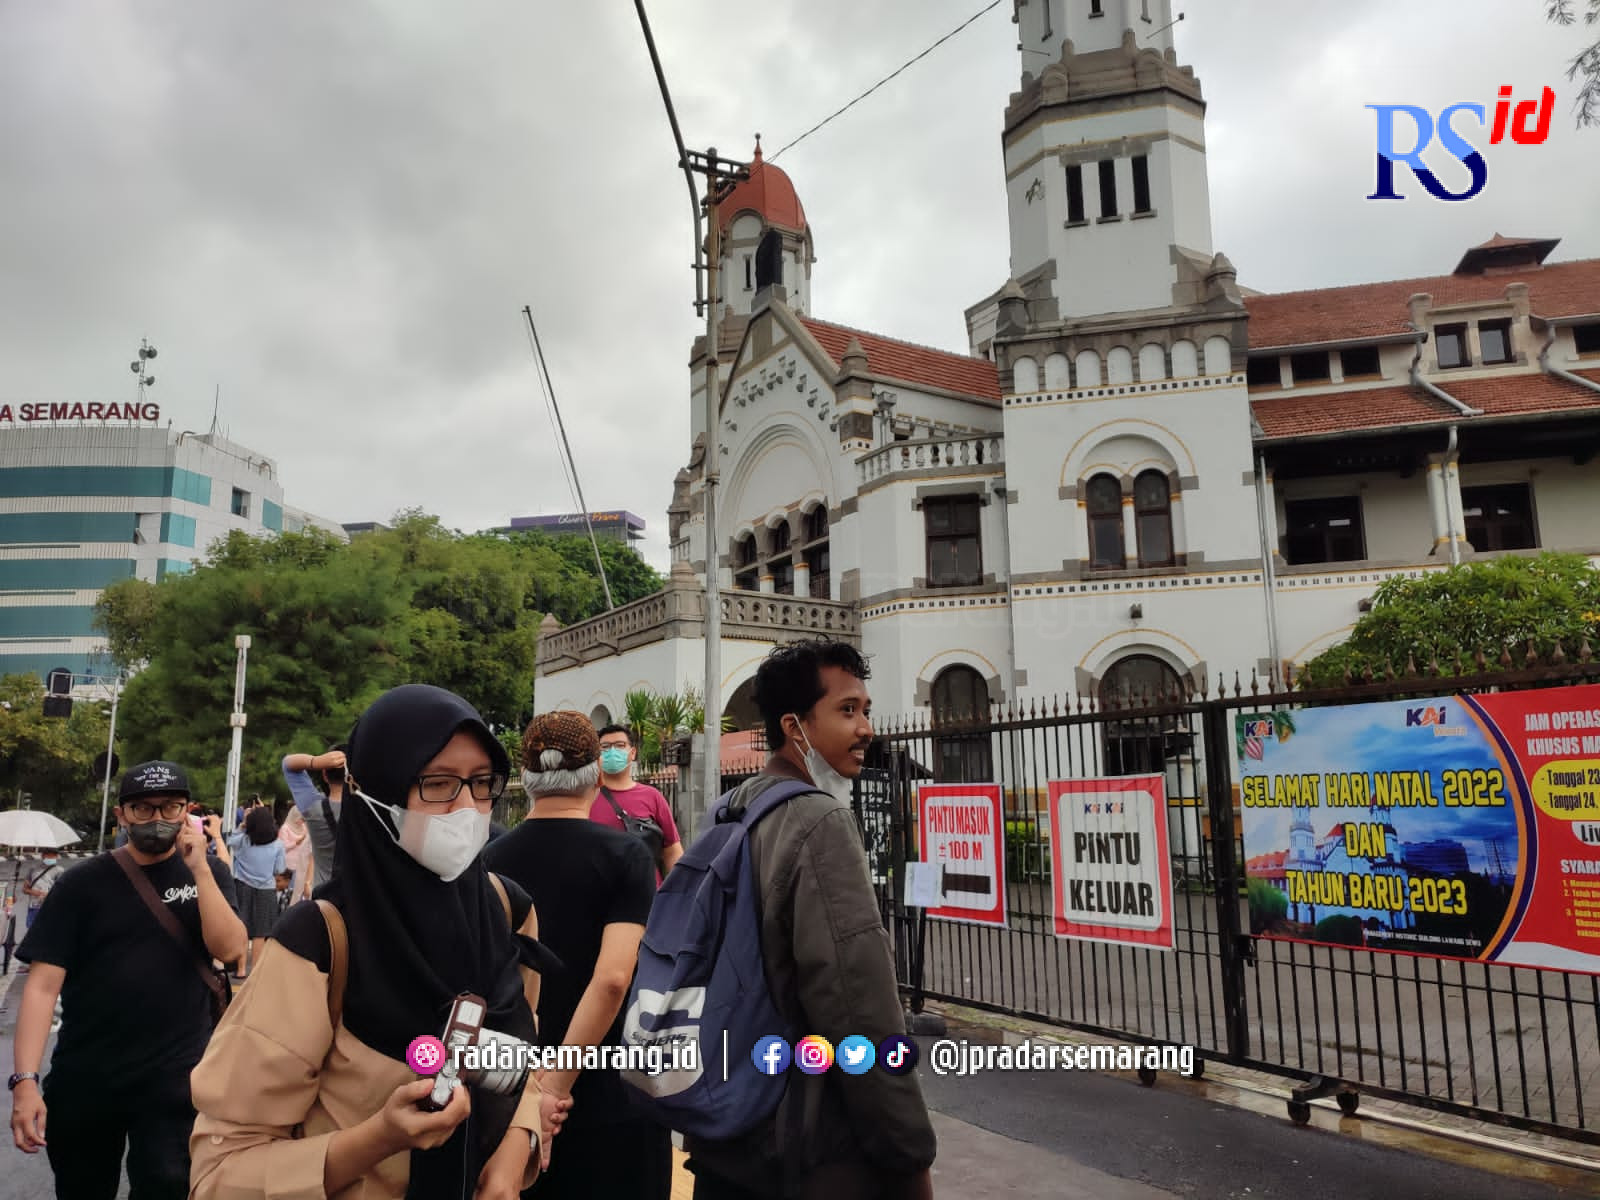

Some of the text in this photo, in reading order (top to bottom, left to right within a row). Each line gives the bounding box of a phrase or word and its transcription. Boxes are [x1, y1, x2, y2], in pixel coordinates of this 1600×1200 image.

[0, 402, 160, 422] A SEMARANG
[1525, 713, 1550, 731] JAM
[1527, 736, 1580, 756] KHUSUS
[1242, 769, 1506, 808] SELAMAT HARI NATAL 2022
[1547, 769, 1586, 788] Tanggal
[1548, 791, 1583, 811] Tanggal
[928, 806, 990, 836] PINTU MASUK
[949, 841, 969, 860] 100
[972, 841, 983, 861] M
[1074, 832, 1140, 865] PINTU
[1344, 822, 1387, 858] DAN
[1070, 879, 1154, 917] KELUAR
[1286, 870, 1468, 915] TAHUN BARU 2023
